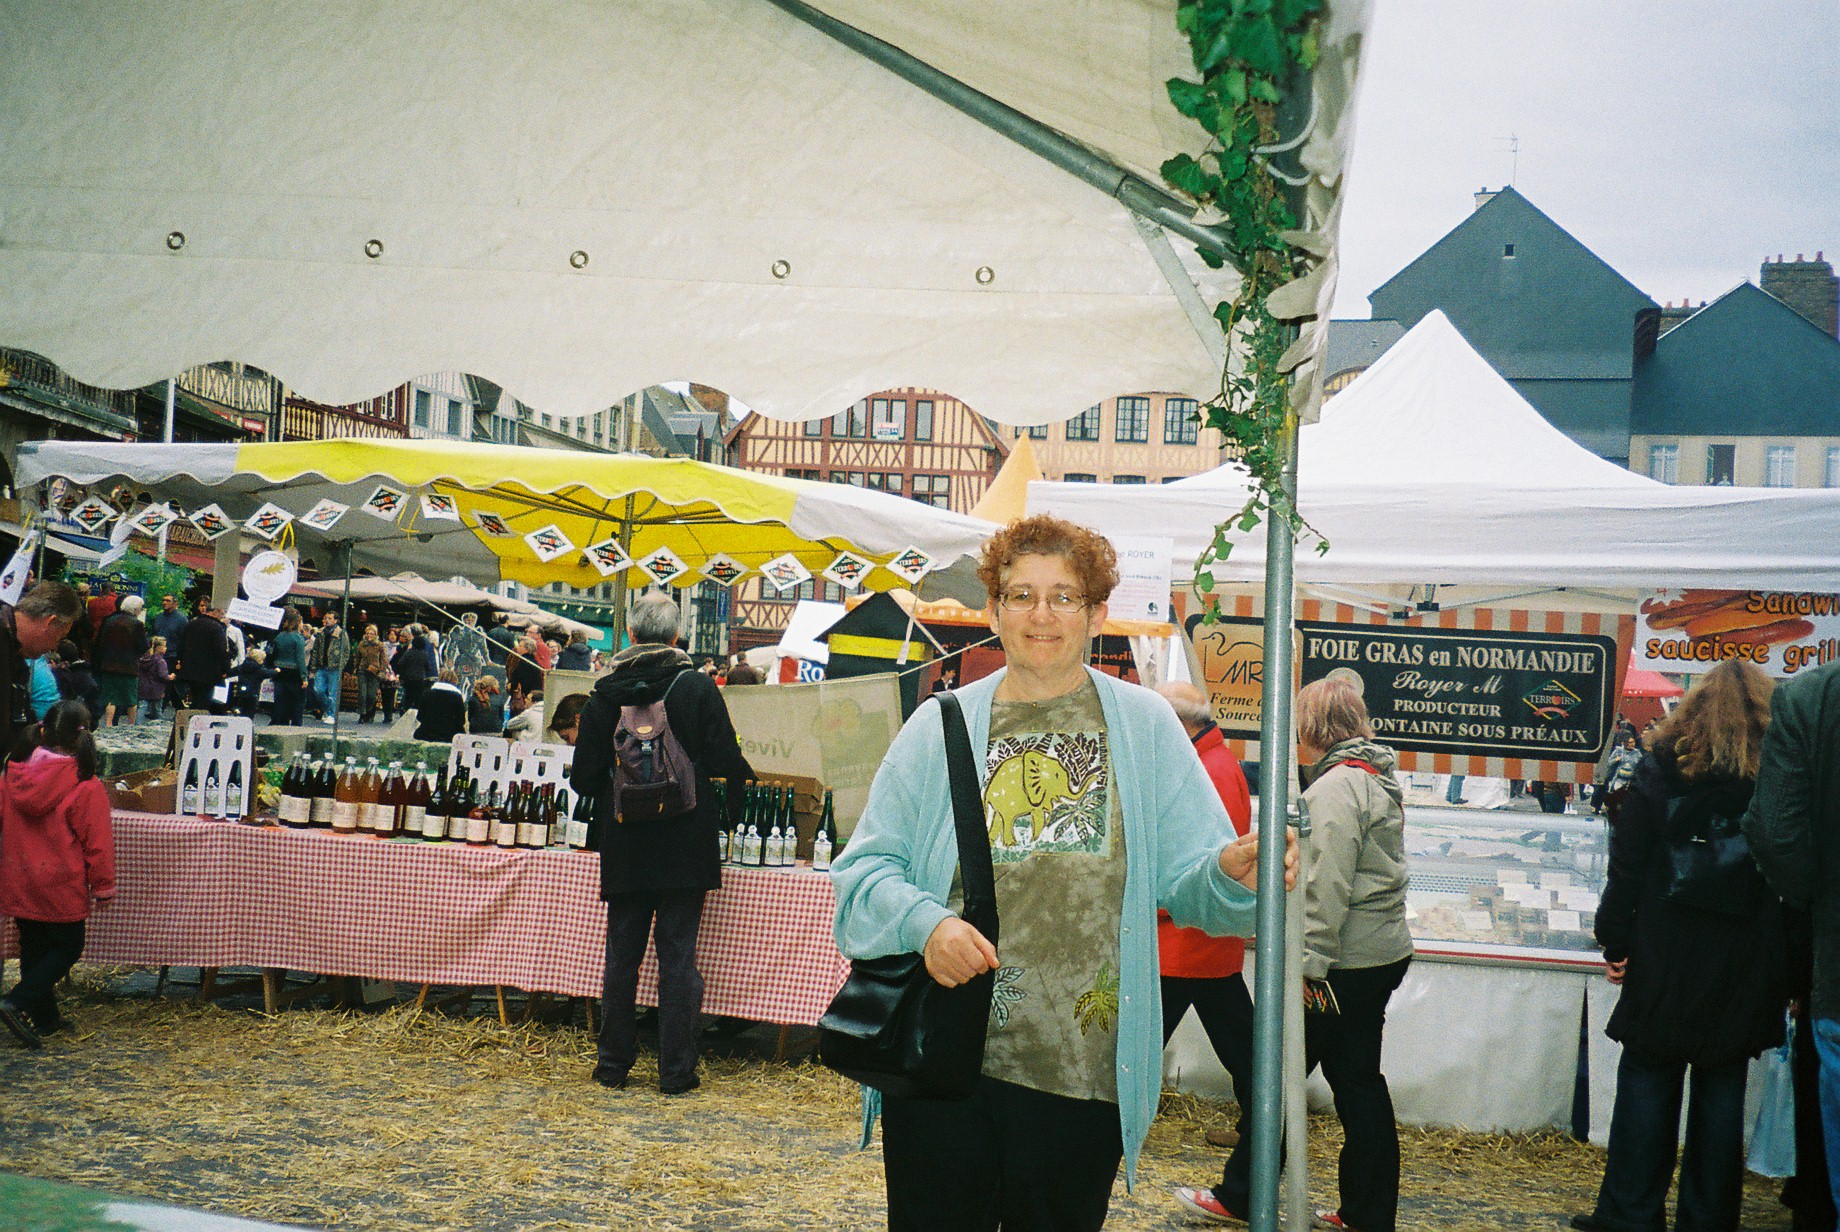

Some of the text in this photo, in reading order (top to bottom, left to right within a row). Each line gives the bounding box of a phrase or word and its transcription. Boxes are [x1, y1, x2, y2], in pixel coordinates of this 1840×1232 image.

[1128, 550, 1155, 559] ROYER
[1308, 638, 1596, 675] FOIE GRAS en NORMANDIE
[1645, 634, 1840, 674] saucisse gril
[1392, 670, 1504, 699] Royer M
[1210, 692, 1254, 707] Ferme
[1394, 699, 1502, 717] PRODUCTEUR
[1371, 717, 1588, 744] ONTAINE SOUS PRÉAUX
